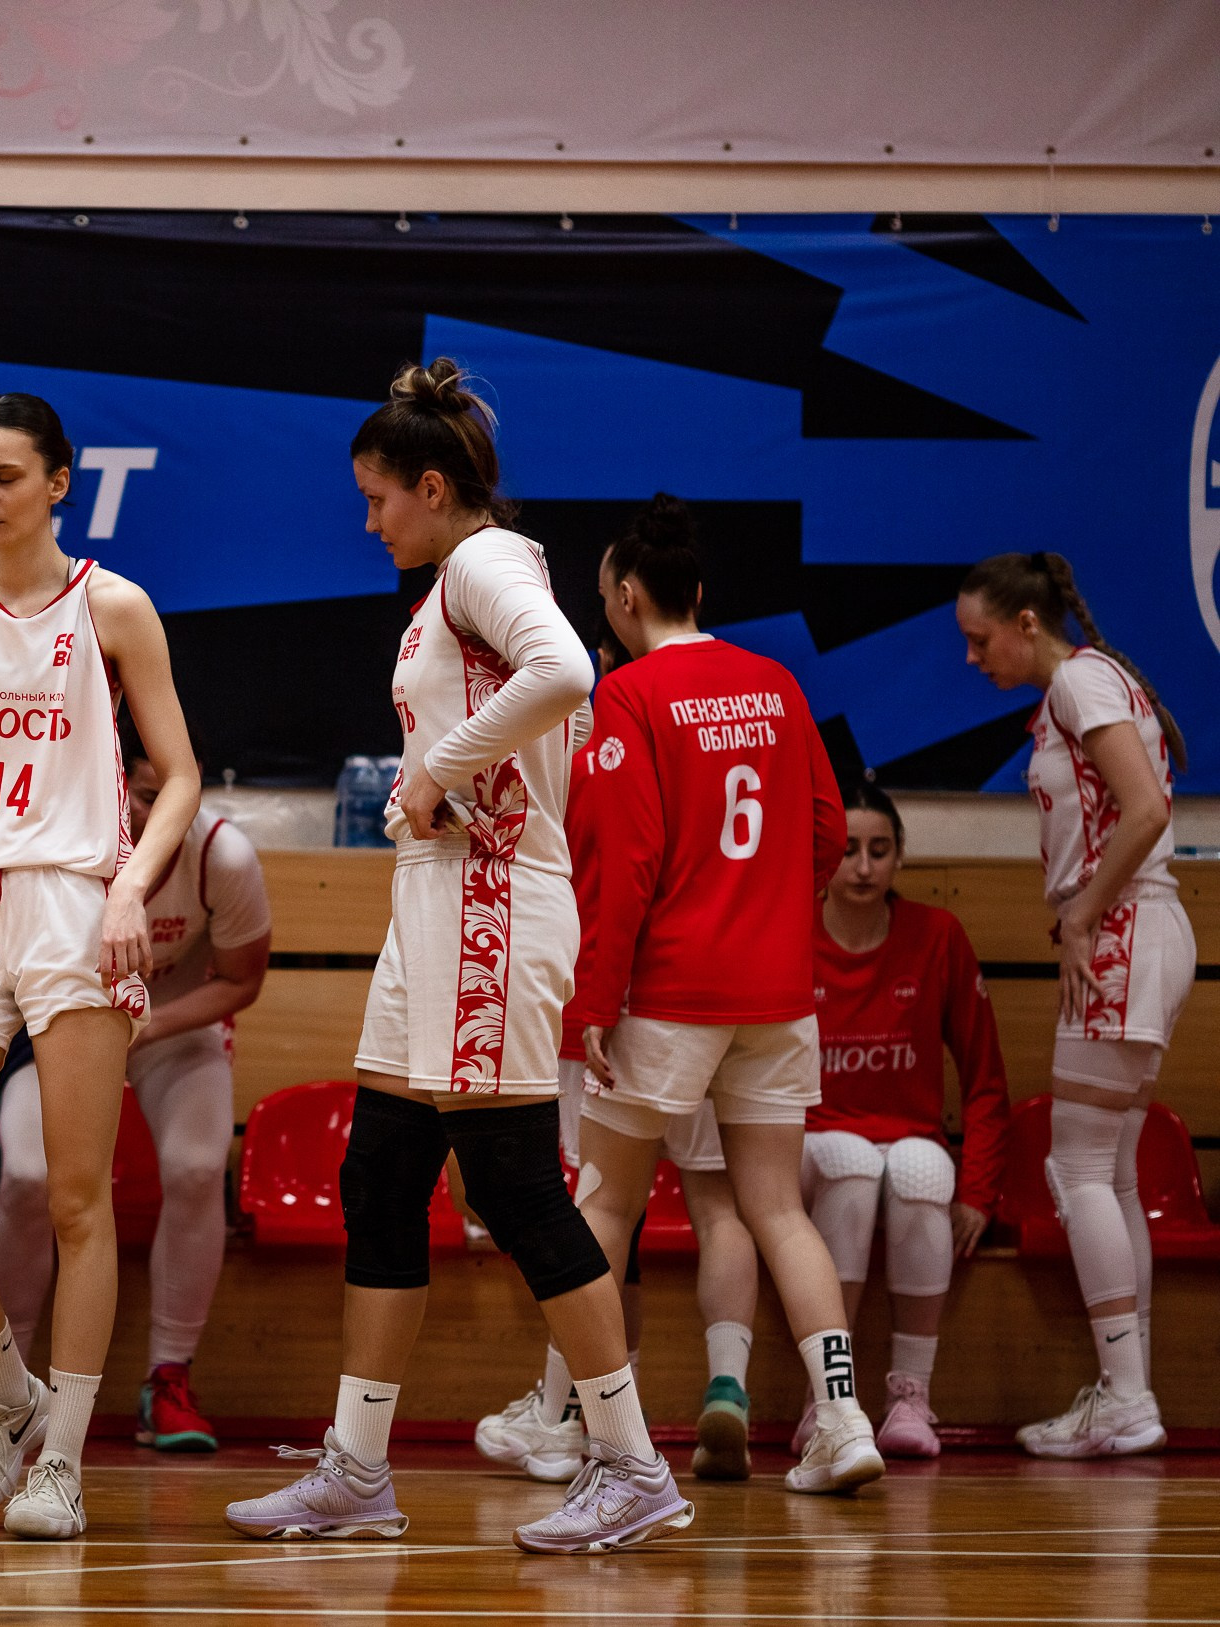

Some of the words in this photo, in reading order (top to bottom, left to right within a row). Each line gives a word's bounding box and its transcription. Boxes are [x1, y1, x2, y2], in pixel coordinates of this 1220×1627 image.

[669, 692, 786, 727] ПЕНЗЕНСКАЯ
[697, 720, 777, 753] ОБЛАСТЬ
[720, 764, 764, 861] 6
